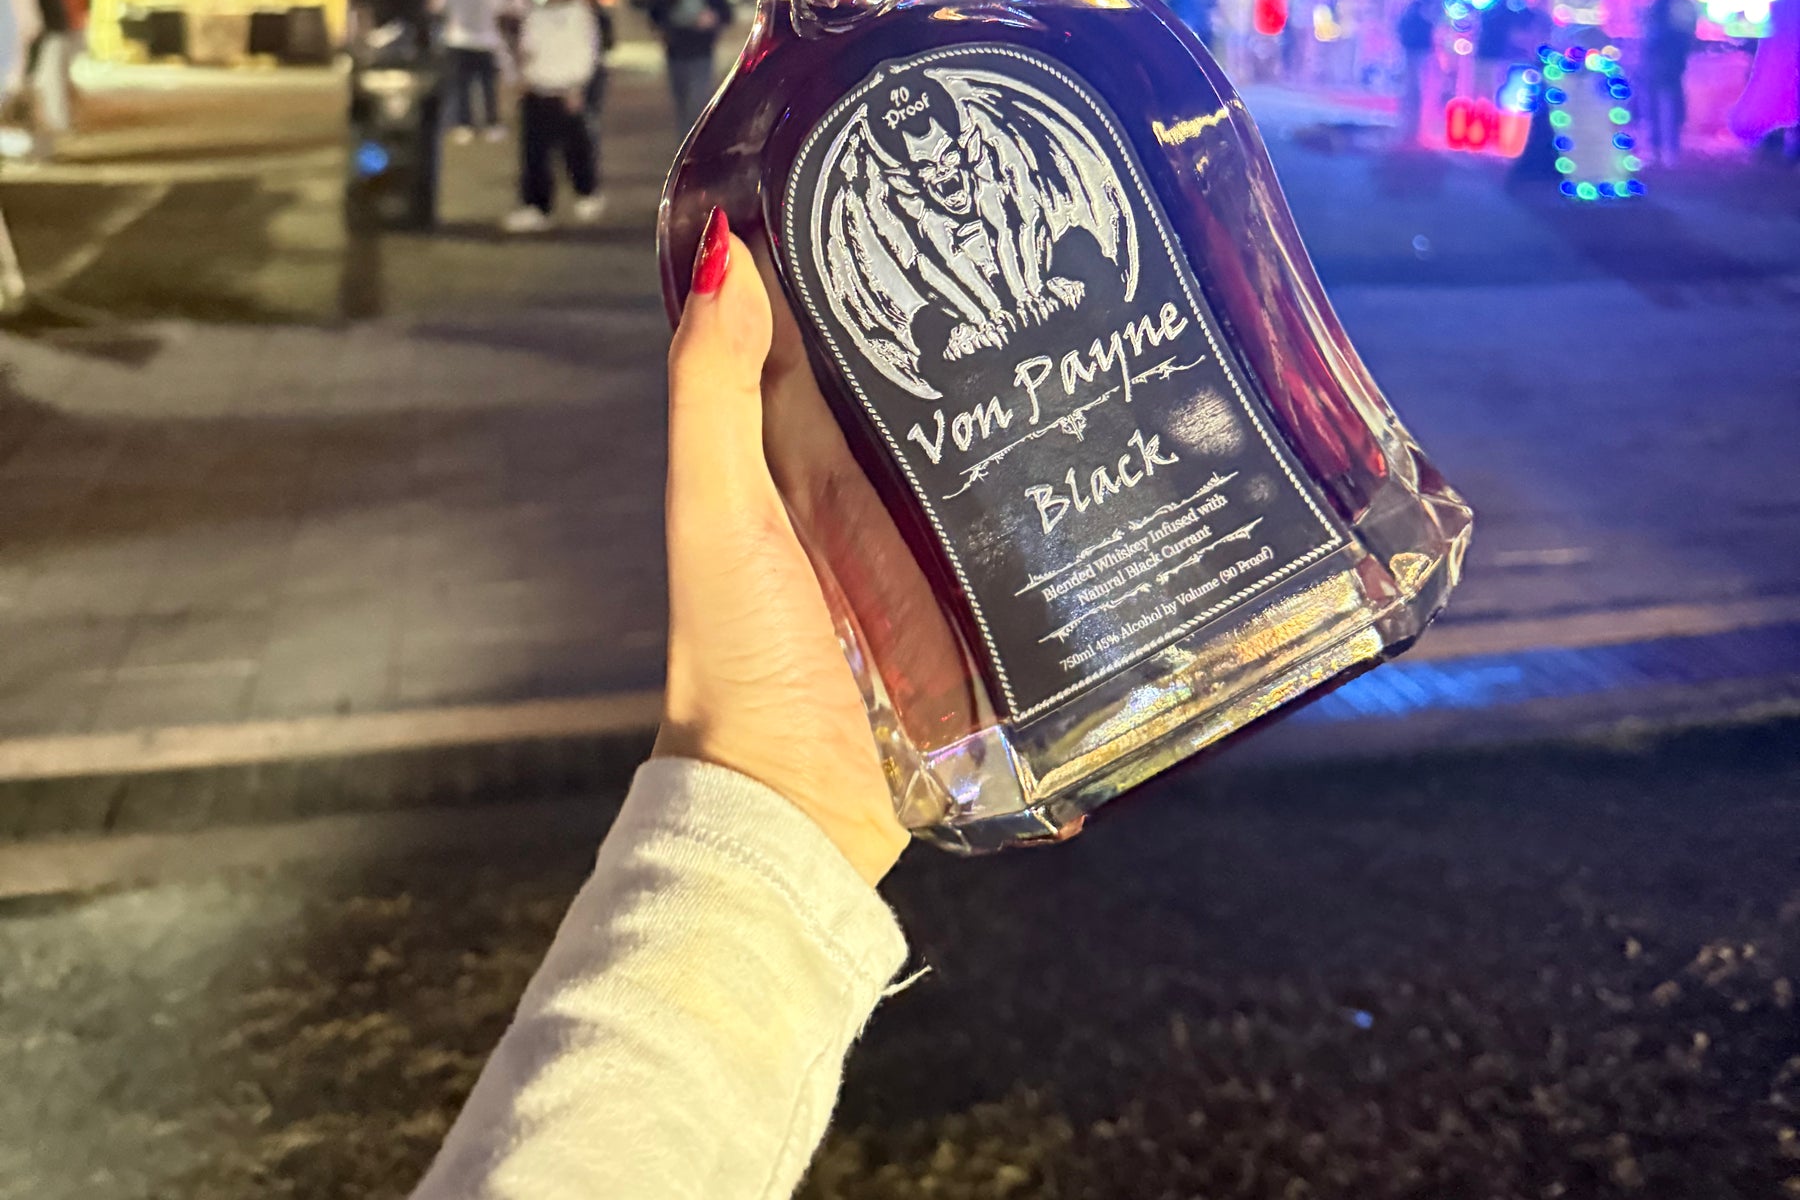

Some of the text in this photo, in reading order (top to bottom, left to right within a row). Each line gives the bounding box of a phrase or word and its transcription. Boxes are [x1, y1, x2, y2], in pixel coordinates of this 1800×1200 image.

[890, 86, 910, 107] 90
[907, 302, 1189, 464] Von Payne
[1025, 429, 1180, 534] Black
[1042, 493, 1229, 601] Blended Whiskey Infused with
[1077, 524, 1213, 606] Natural Black Currant
[1059, 545, 1275, 672] 750ml 45% Alcohol by Volume (90 Proof)
